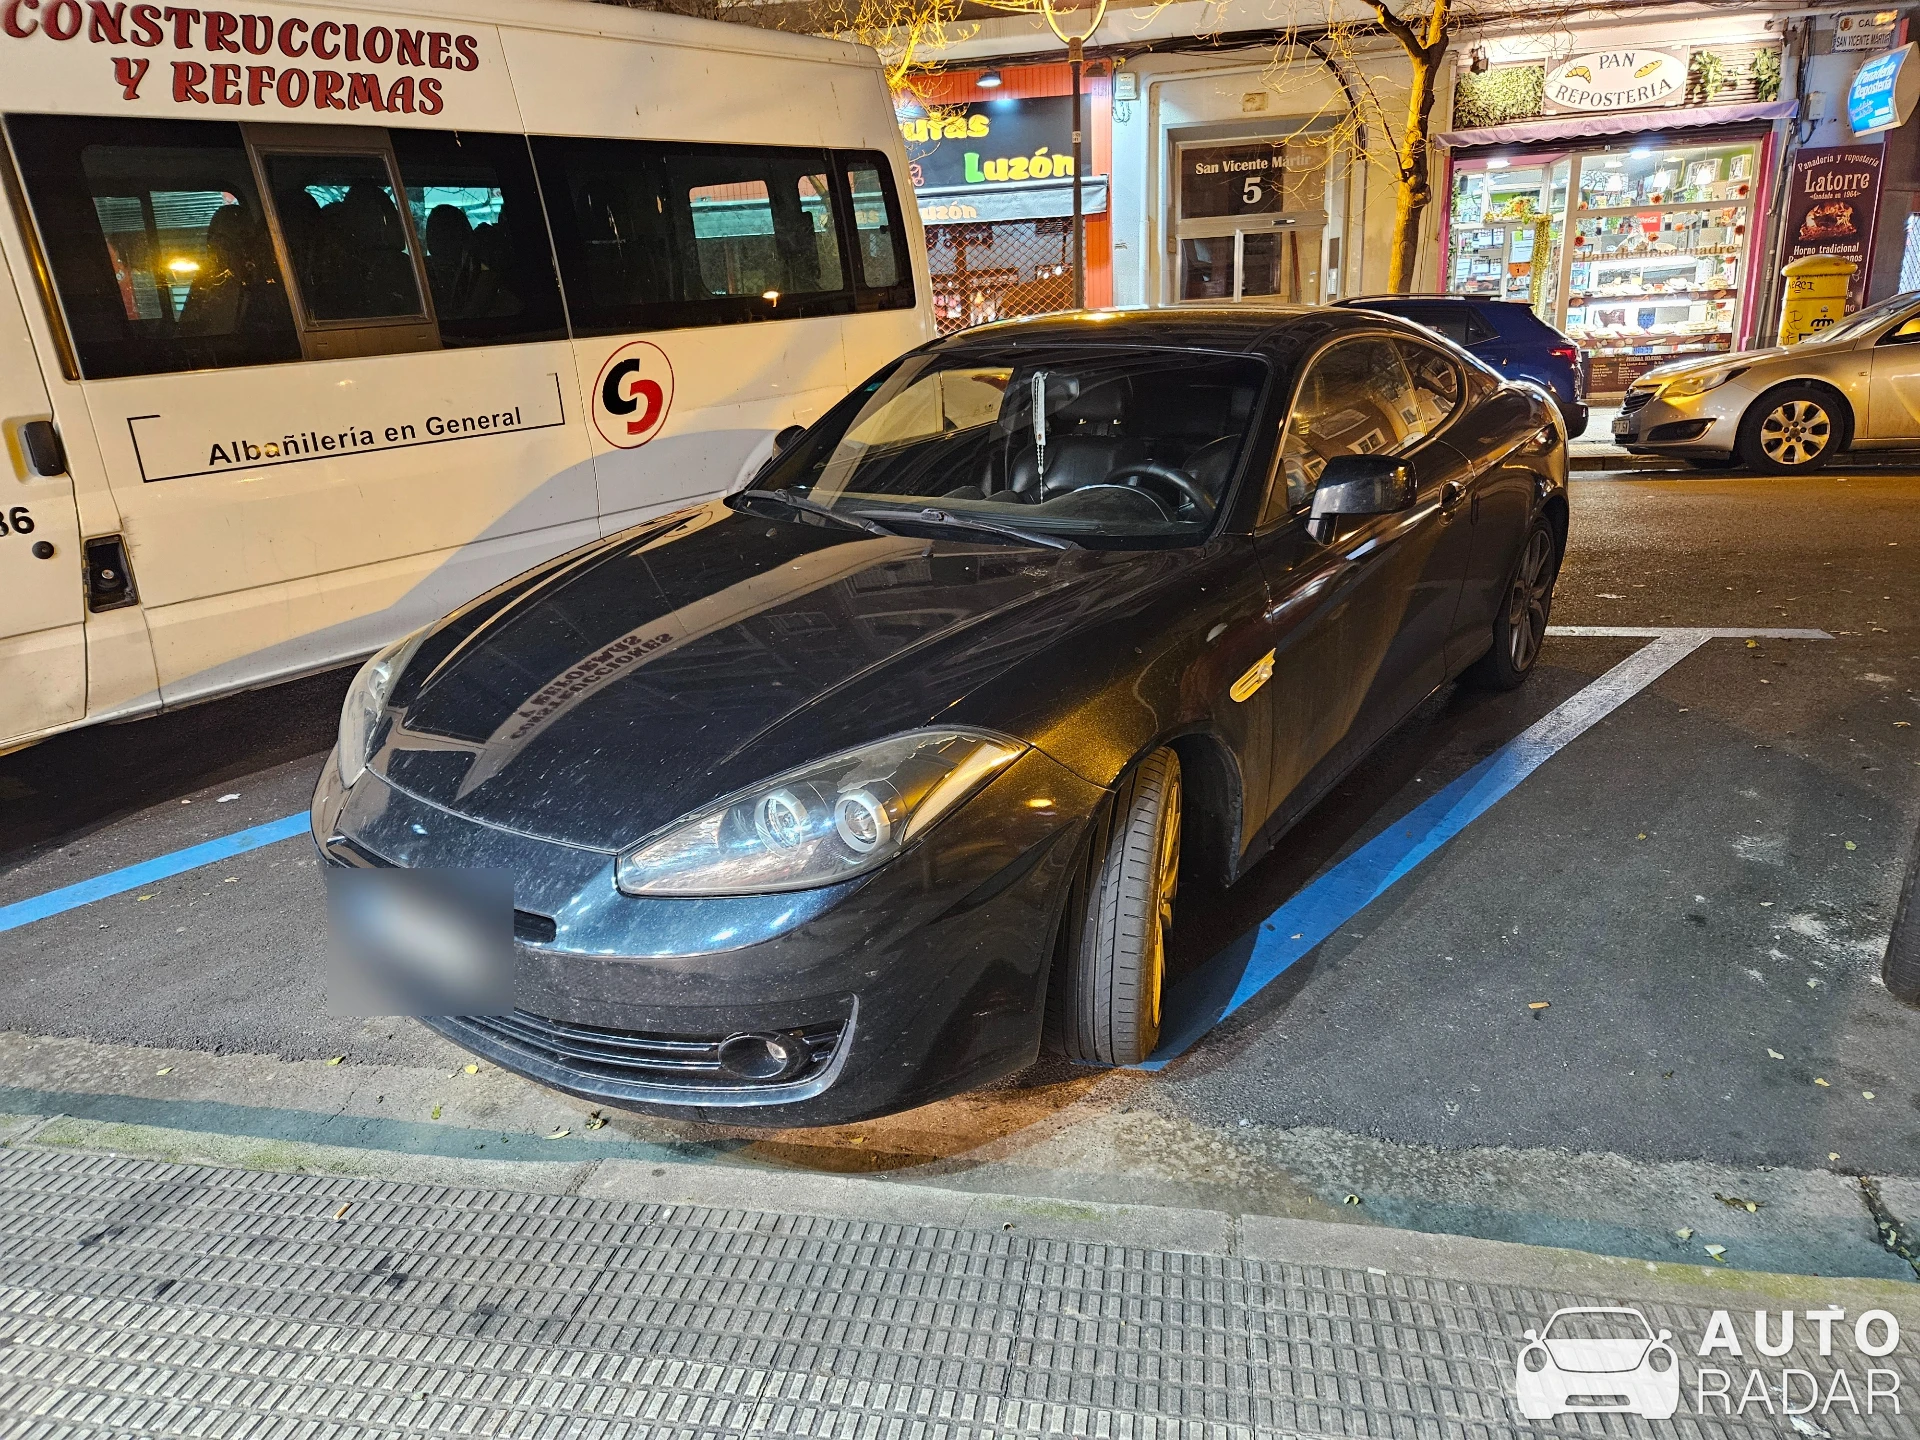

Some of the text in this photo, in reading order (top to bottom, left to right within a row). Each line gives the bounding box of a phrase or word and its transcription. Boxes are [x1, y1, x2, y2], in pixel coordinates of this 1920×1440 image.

[1, 0, 480, 72] CONSTRUCCIONES
[1836, 36, 1847, 47] SAN
[1848, 34, 1870, 46] VICENTE
[1599, 53, 1636, 70] PAN
[111, 57, 445, 116] Y REFORMAS
[1555, 78, 1673, 107] REPOSTERIA
[964, 147, 1075, 183] Luzón
[1195, 162, 1219, 175] San
[1222, 159, 1269, 172] Vicente
[1797, 153, 1880, 173] Panadería y repostería
[1242, 176, 1262, 204] 5
[1804, 169, 1870, 193] Latorre
[1582, 250, 1612, 263] Pan
[1615, 247, 1634, 260] de
[1683, 242, 1735, 257] madre
[1793, 242, 1860, 256] Horno tradicional
[208, 406, 523, 467] Albañilería en General
